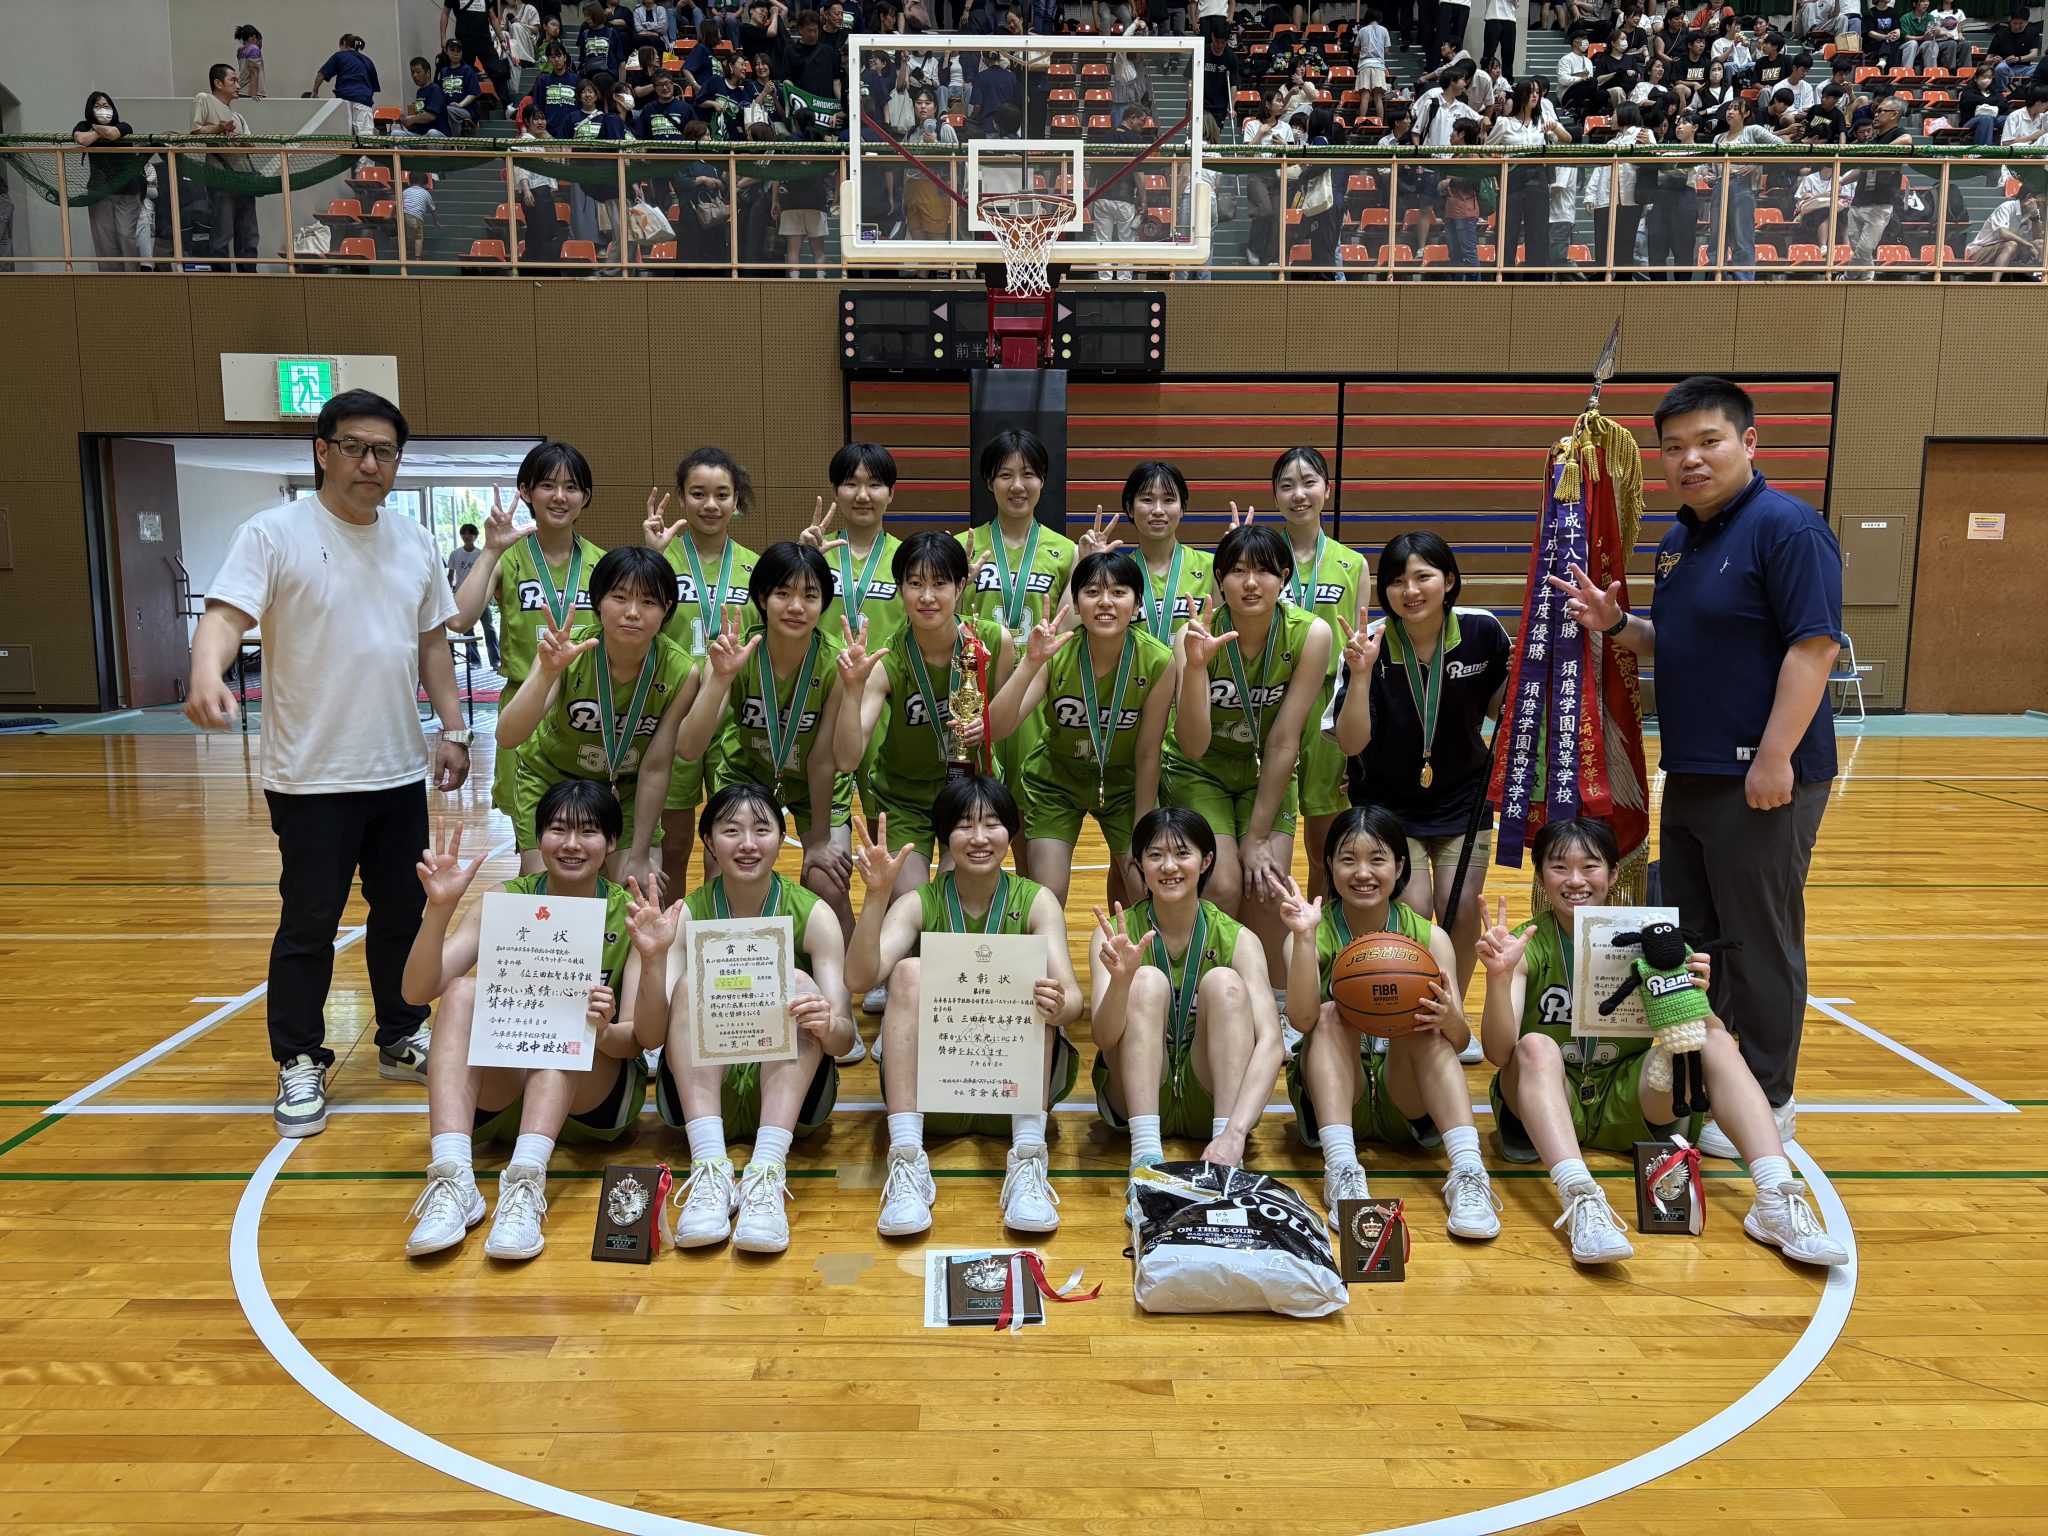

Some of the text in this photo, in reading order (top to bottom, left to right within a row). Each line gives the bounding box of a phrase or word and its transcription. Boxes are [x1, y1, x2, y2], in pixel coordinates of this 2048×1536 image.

[1446, 660, 1489, 680] Rams
[1555, 660, 1579, 803] 須磨学園高等学校
[1505, 681, 1541, 820] 須磨学園高等学校
[486, 982, 588, 998] 輝かしい成績に心から
[1372, 984, 1398, 996] FIBA
[486, 997, 545, 1012] 賛辞を贈る
[1223, 1227, 1263, 1236] COURT
